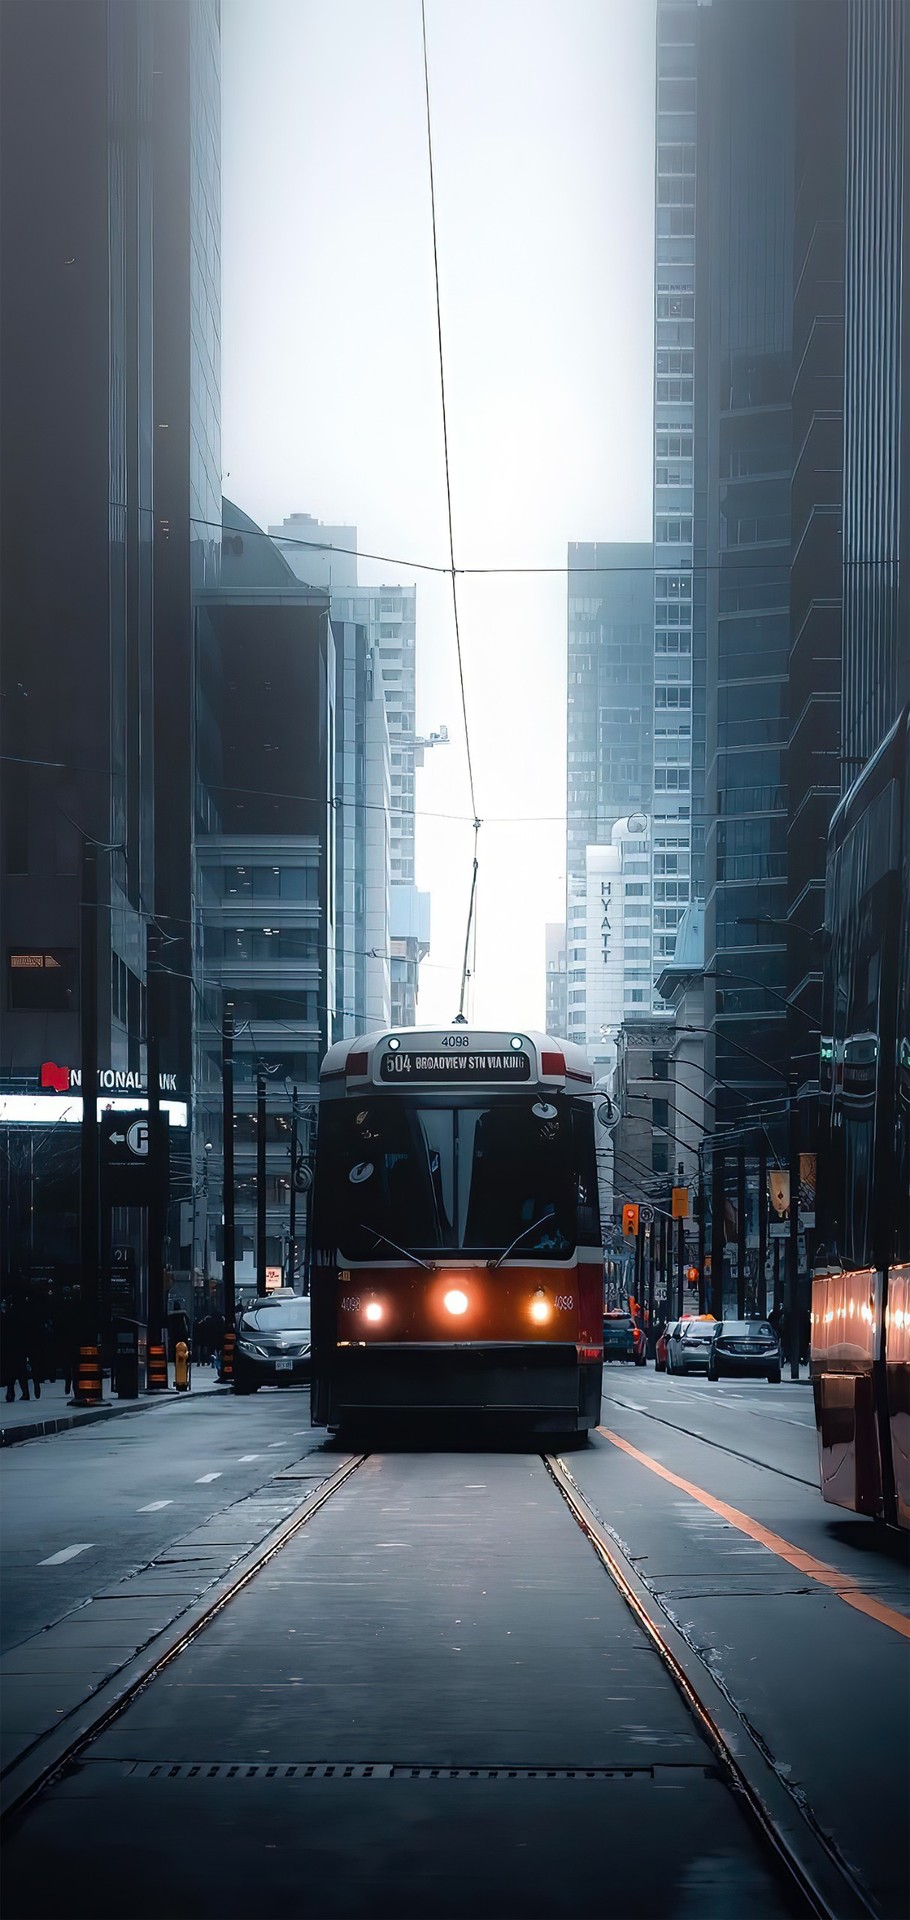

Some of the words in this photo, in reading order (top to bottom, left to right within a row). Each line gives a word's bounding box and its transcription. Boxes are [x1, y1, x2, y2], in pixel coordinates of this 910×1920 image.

[601, 881, 611, 964] HYATT
[441, 1036, 469, 1047] 4098
[386, 1054, 412, 1073] 504
[415, 1056, 467, 1069] BROADVIEW
[468, 1056, 486, 1069] STN
[487, 1056, 502, 1069] VIA
[503, 1056, 524, 1069] KING
